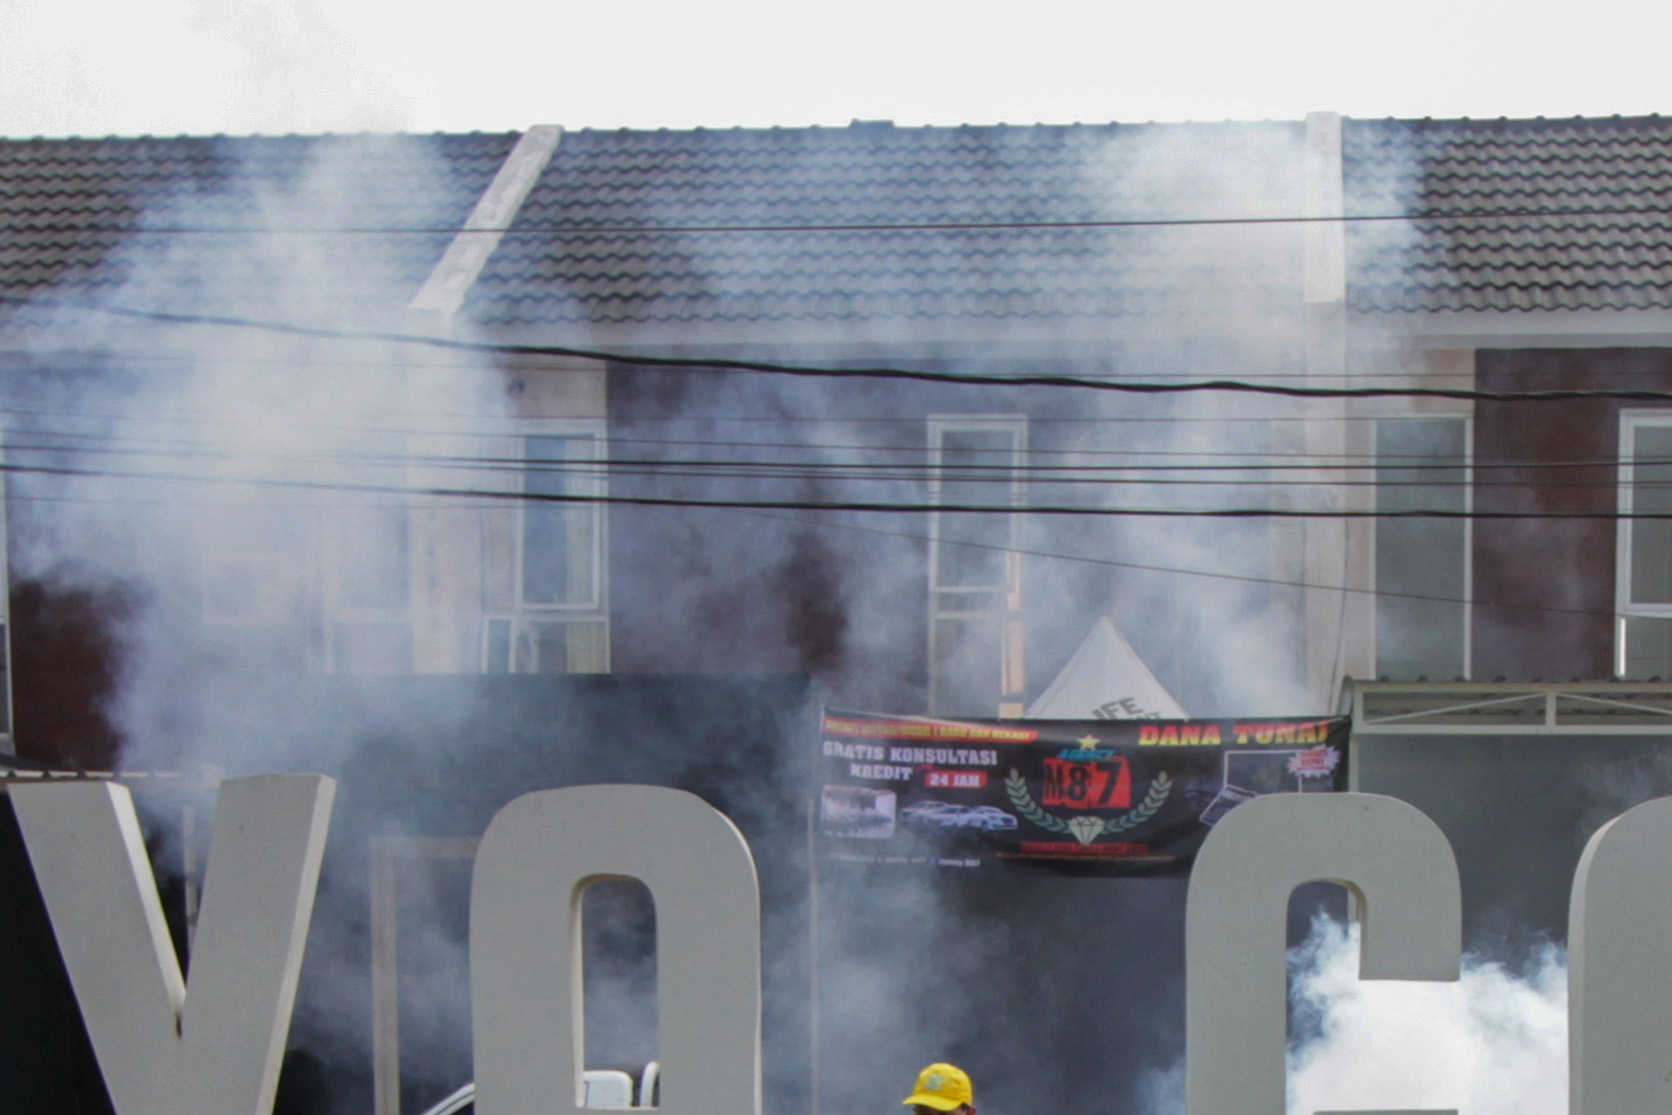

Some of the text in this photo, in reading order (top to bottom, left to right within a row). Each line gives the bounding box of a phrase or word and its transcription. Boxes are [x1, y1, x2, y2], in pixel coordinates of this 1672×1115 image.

[1138, 724, 1222, 746] DANA
[823, 741, 998, 765] GRATIS KONSULTASI
[850, 763, 913, 781] KREDIT
[929, 773, 981, 788] 24 JAM
